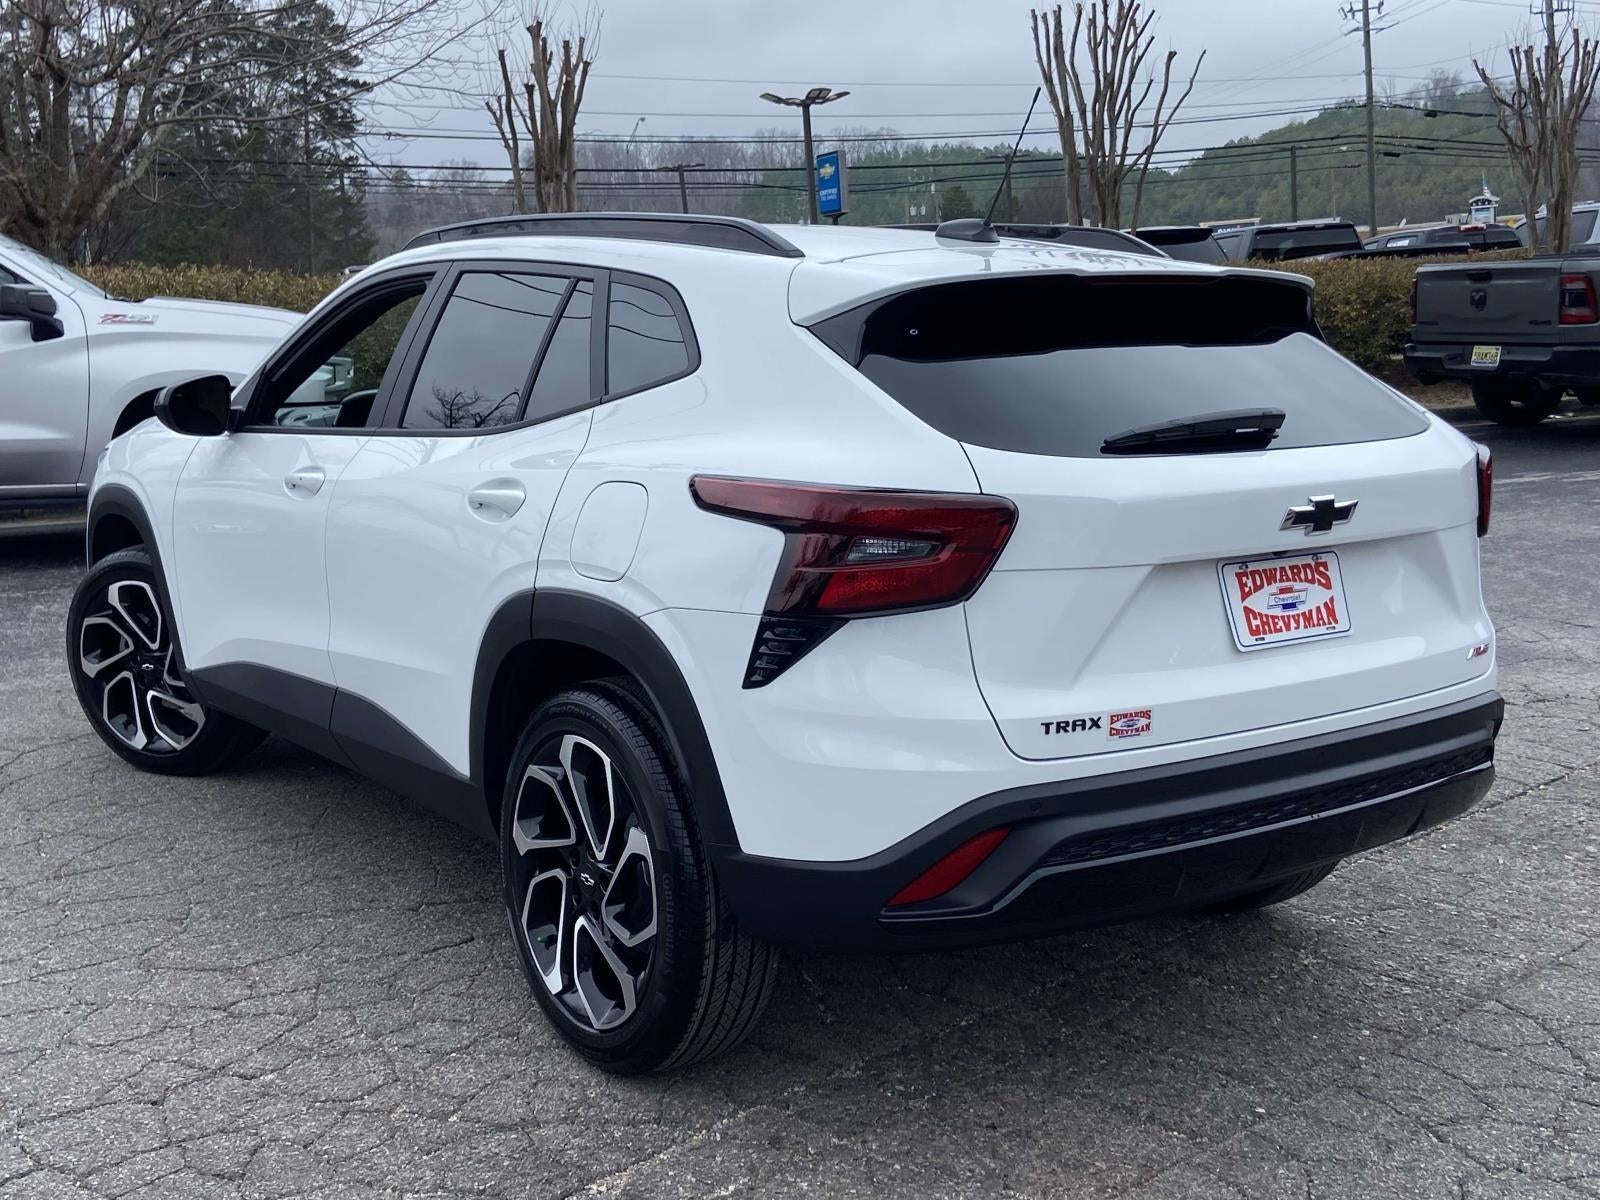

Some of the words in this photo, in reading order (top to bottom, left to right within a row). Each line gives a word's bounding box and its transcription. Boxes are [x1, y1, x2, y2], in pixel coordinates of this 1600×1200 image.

[1235, 561, 1332, 603] EDWARDS
[1242, 595, 1339, 637] CHEVYMAN
[1040, 716, 1102, 735] TRAX
[1110, 710, 1152, 725] EDWARDS
[1109, 722, 1152, 736] CHEVYMAN
